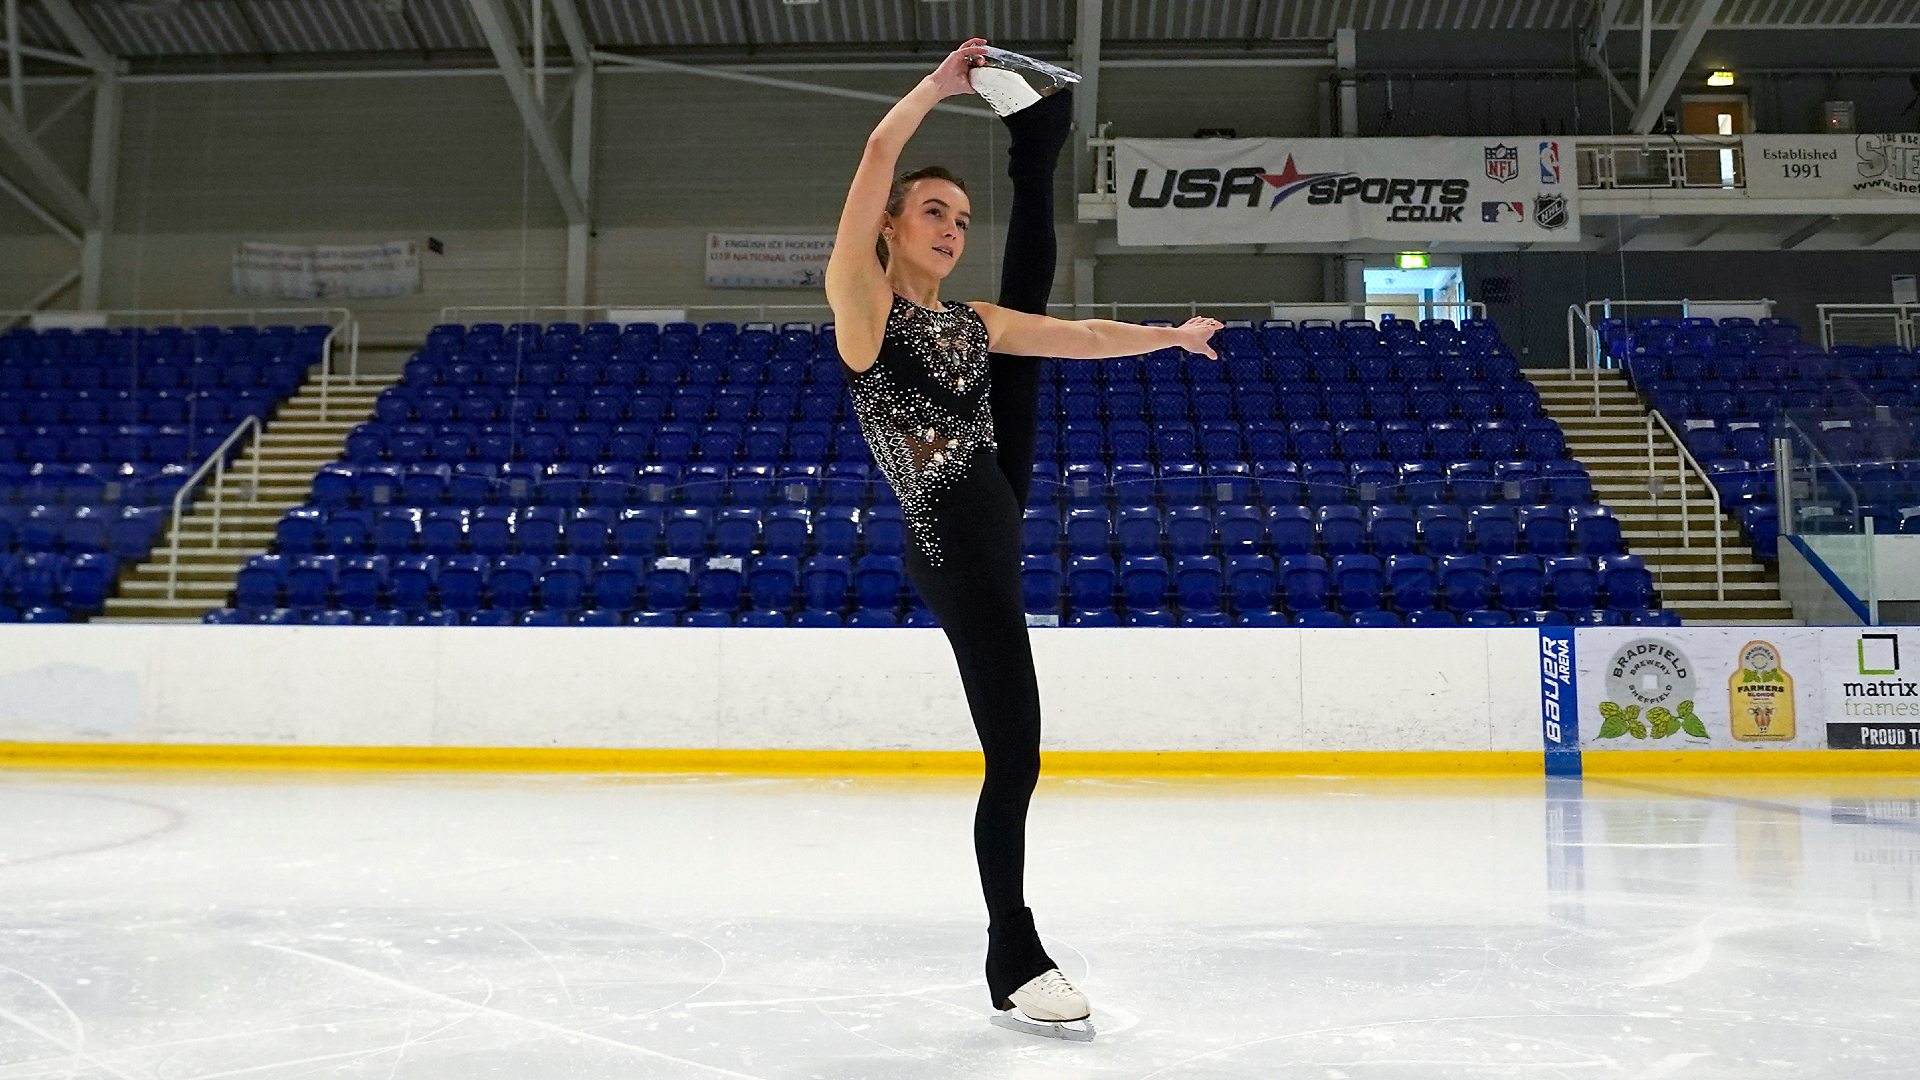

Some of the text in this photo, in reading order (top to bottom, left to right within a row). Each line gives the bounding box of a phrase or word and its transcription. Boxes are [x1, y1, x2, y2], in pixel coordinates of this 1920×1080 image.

[1763, 148, 1838, 160] Established
[1488, 160, 1516, 178] NFL
[1782, 163, 1822, 178] 1991
[1127, 167, 1470, 208] USA SPORTS
[1386, 205, 1465, 223] .CO.UK
[1540, 203, 1561, 222] NHL
[1557, 639, 1571, 684] ARENA
[1612, 643, 1687, 679] BRADFIELD
[1629, 659, 1671, 676] BREWERY
[1628, 684, 1673, 704] SHEFFIELD
[1737, 685, 1785, 693] FARMERS
[1843, 677, 1918, 697] matrix
[1844, 698, 1919, 716] frames
